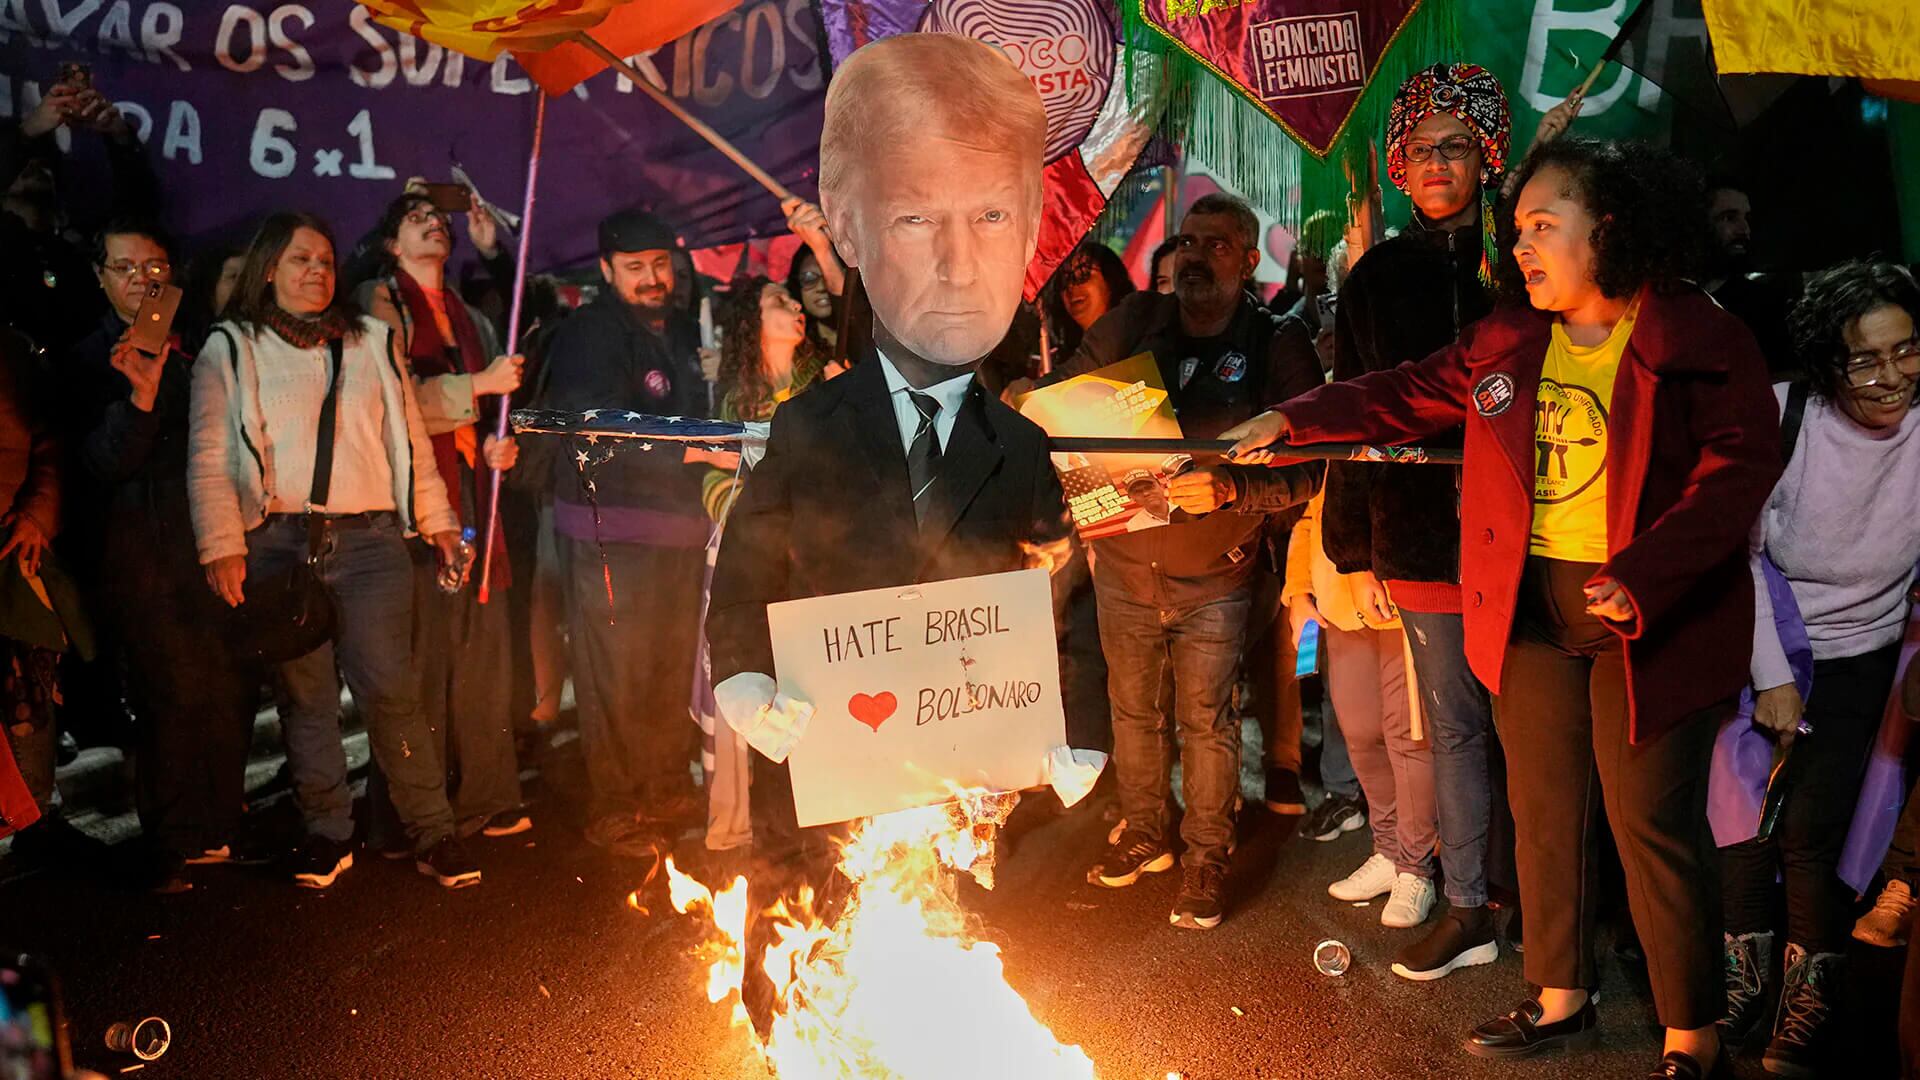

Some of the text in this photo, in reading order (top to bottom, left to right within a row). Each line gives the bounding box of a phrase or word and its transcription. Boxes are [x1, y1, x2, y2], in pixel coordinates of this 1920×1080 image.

[215, 4, 315, 82] OS
[348, 4, 591, 100] SUE
[1258, 19, 1357, 60] BANCADA
[1264, 51, 1361, 93] FEMINISTA
[1490, 378, 1511, 402] FIM
[824, 605, 1010, 663] HATE BRASIL
[916, 681, 1041, 726] BOLSONARO
